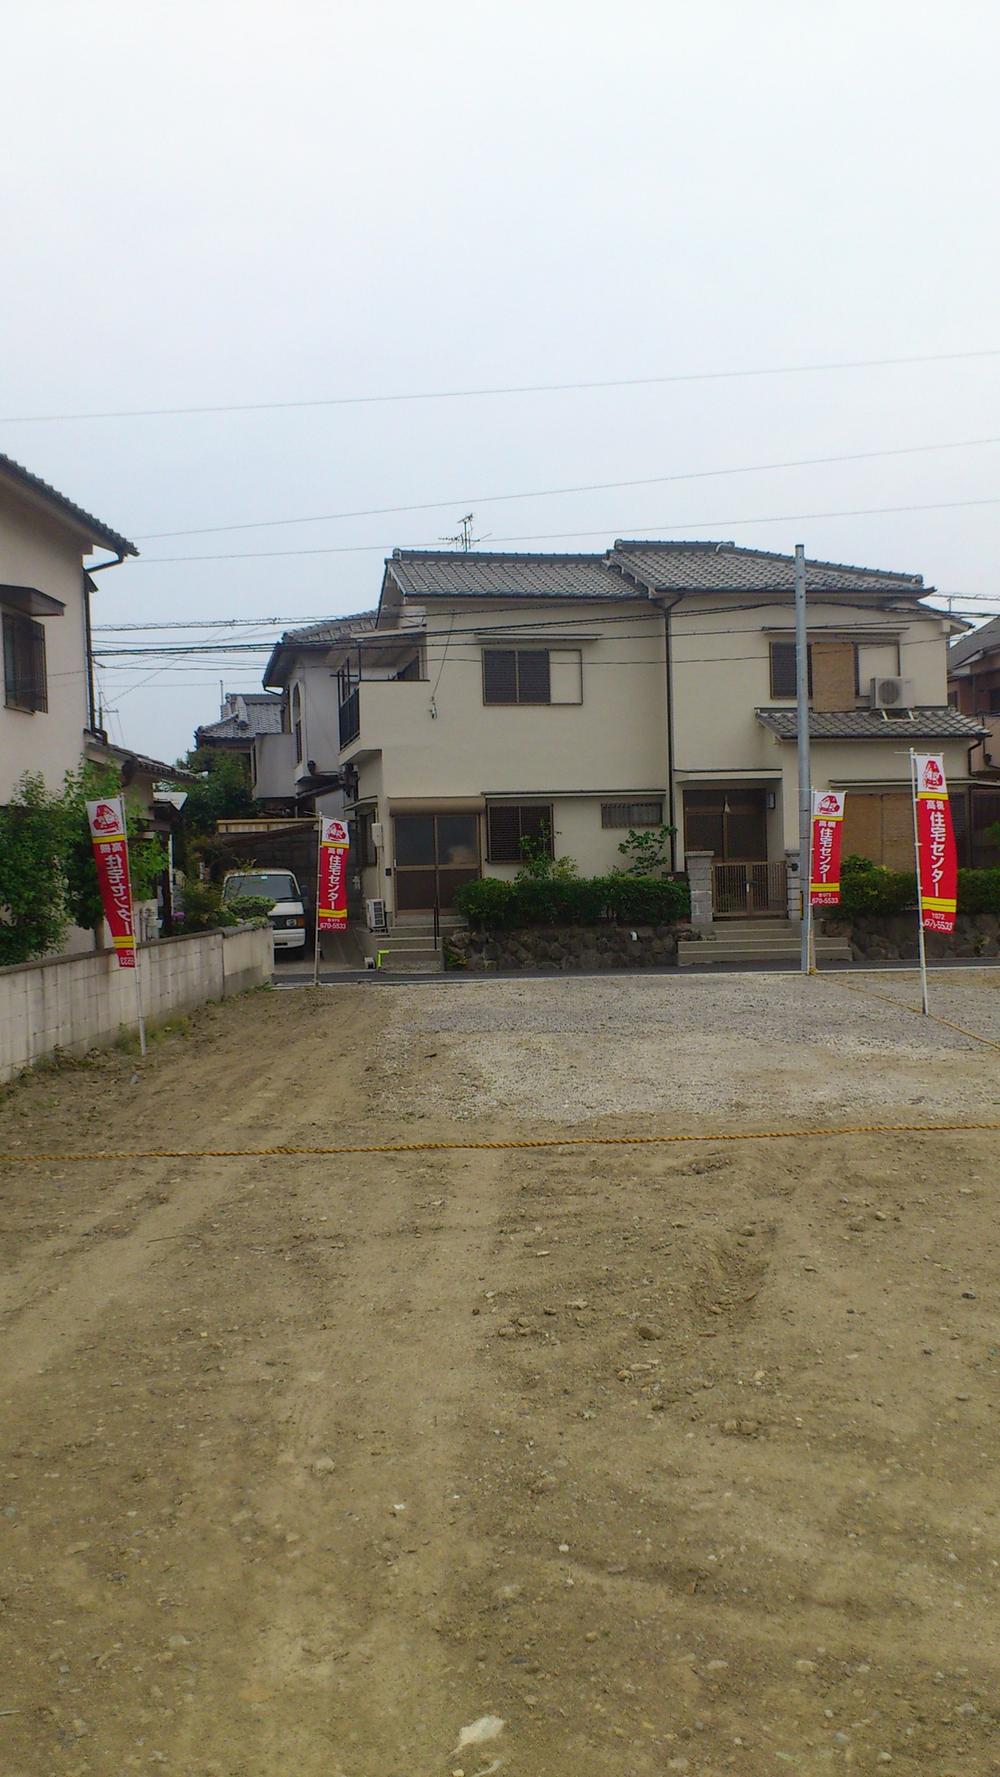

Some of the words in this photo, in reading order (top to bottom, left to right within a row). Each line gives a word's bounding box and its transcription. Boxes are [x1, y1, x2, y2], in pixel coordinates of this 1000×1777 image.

[819, 828, 833, 883] 住宅センター
[929, 811, 946, 897] 住宅センター
[328, 855, 342, 910] 住宅センター
